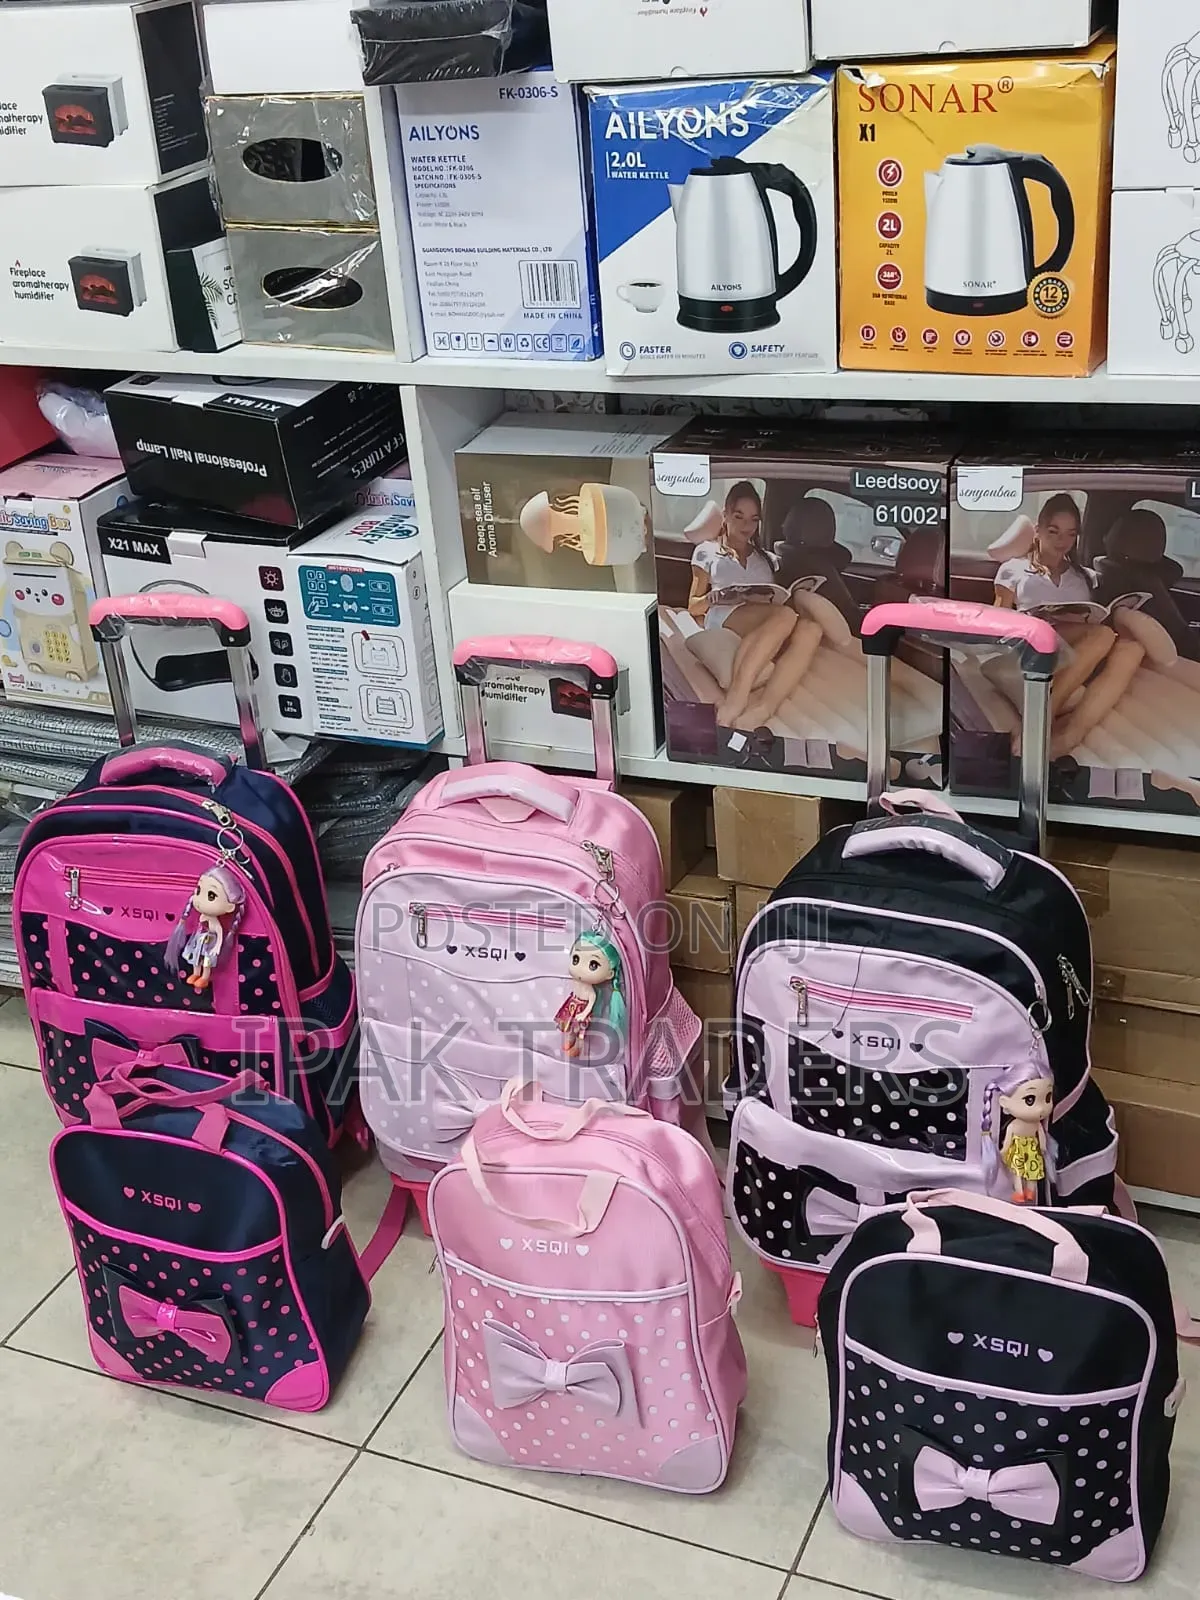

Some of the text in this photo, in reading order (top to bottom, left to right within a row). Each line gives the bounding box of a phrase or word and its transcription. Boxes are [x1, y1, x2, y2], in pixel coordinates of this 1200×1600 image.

[499, 86, 559, 100] FK-0306-S
[858, 83, 998, 113] SONAR
[604, 101, 750, 140] AILYONS
[408, 124, 480, 142] AILYONS
[859, 123, 876, 142] X1
[410, 154, 467, 164] WATER KETTLE
[610, 151, 647, 168] 2.0L
[611, 171, 670, 180] WATER KETTLE
[882, 218, 898, 232] 2L
[9, 267, 46, 279] Fireplace
[12, 279, 70, 292] aromatherapy
[710, 283, 743, 291] AILYONS
[962, 280, 993, 289] SONAR
[1042, 286, 1059, 300] 12
[14, 289, 55, 301] humidifier
[523, 312, 583, 320] MADE IN CHINA
[639, 345, 672, 354] FASTER
[751, 344, 785, 353] SAFETY
[223, 396, 281, 412] X11 MAX
[136, 438, 268, 478] Professional Nail Lamp
[855, 471, 940, 495] Leedsooy
[13, 512, 48, 531] Saving
[474, 503, 483, 523] sea
[482, 481, 499, 558] Aroma Diffuser
[875, 504, 939, 526] 61002
[107, 536, 161, 556] X21 MAX
[476, 524, 487, 552] Deep
[120, 906, 160, 922] XSQI
[464, 945, 508, 962] XSQI
[851, 1032, 901, 1052] XSQI
[140, 1189, 182, 1212] XSQI
[521, 1238, 569, 1256] XSQI
[972, 1333, 1030, 1358] XSQI
